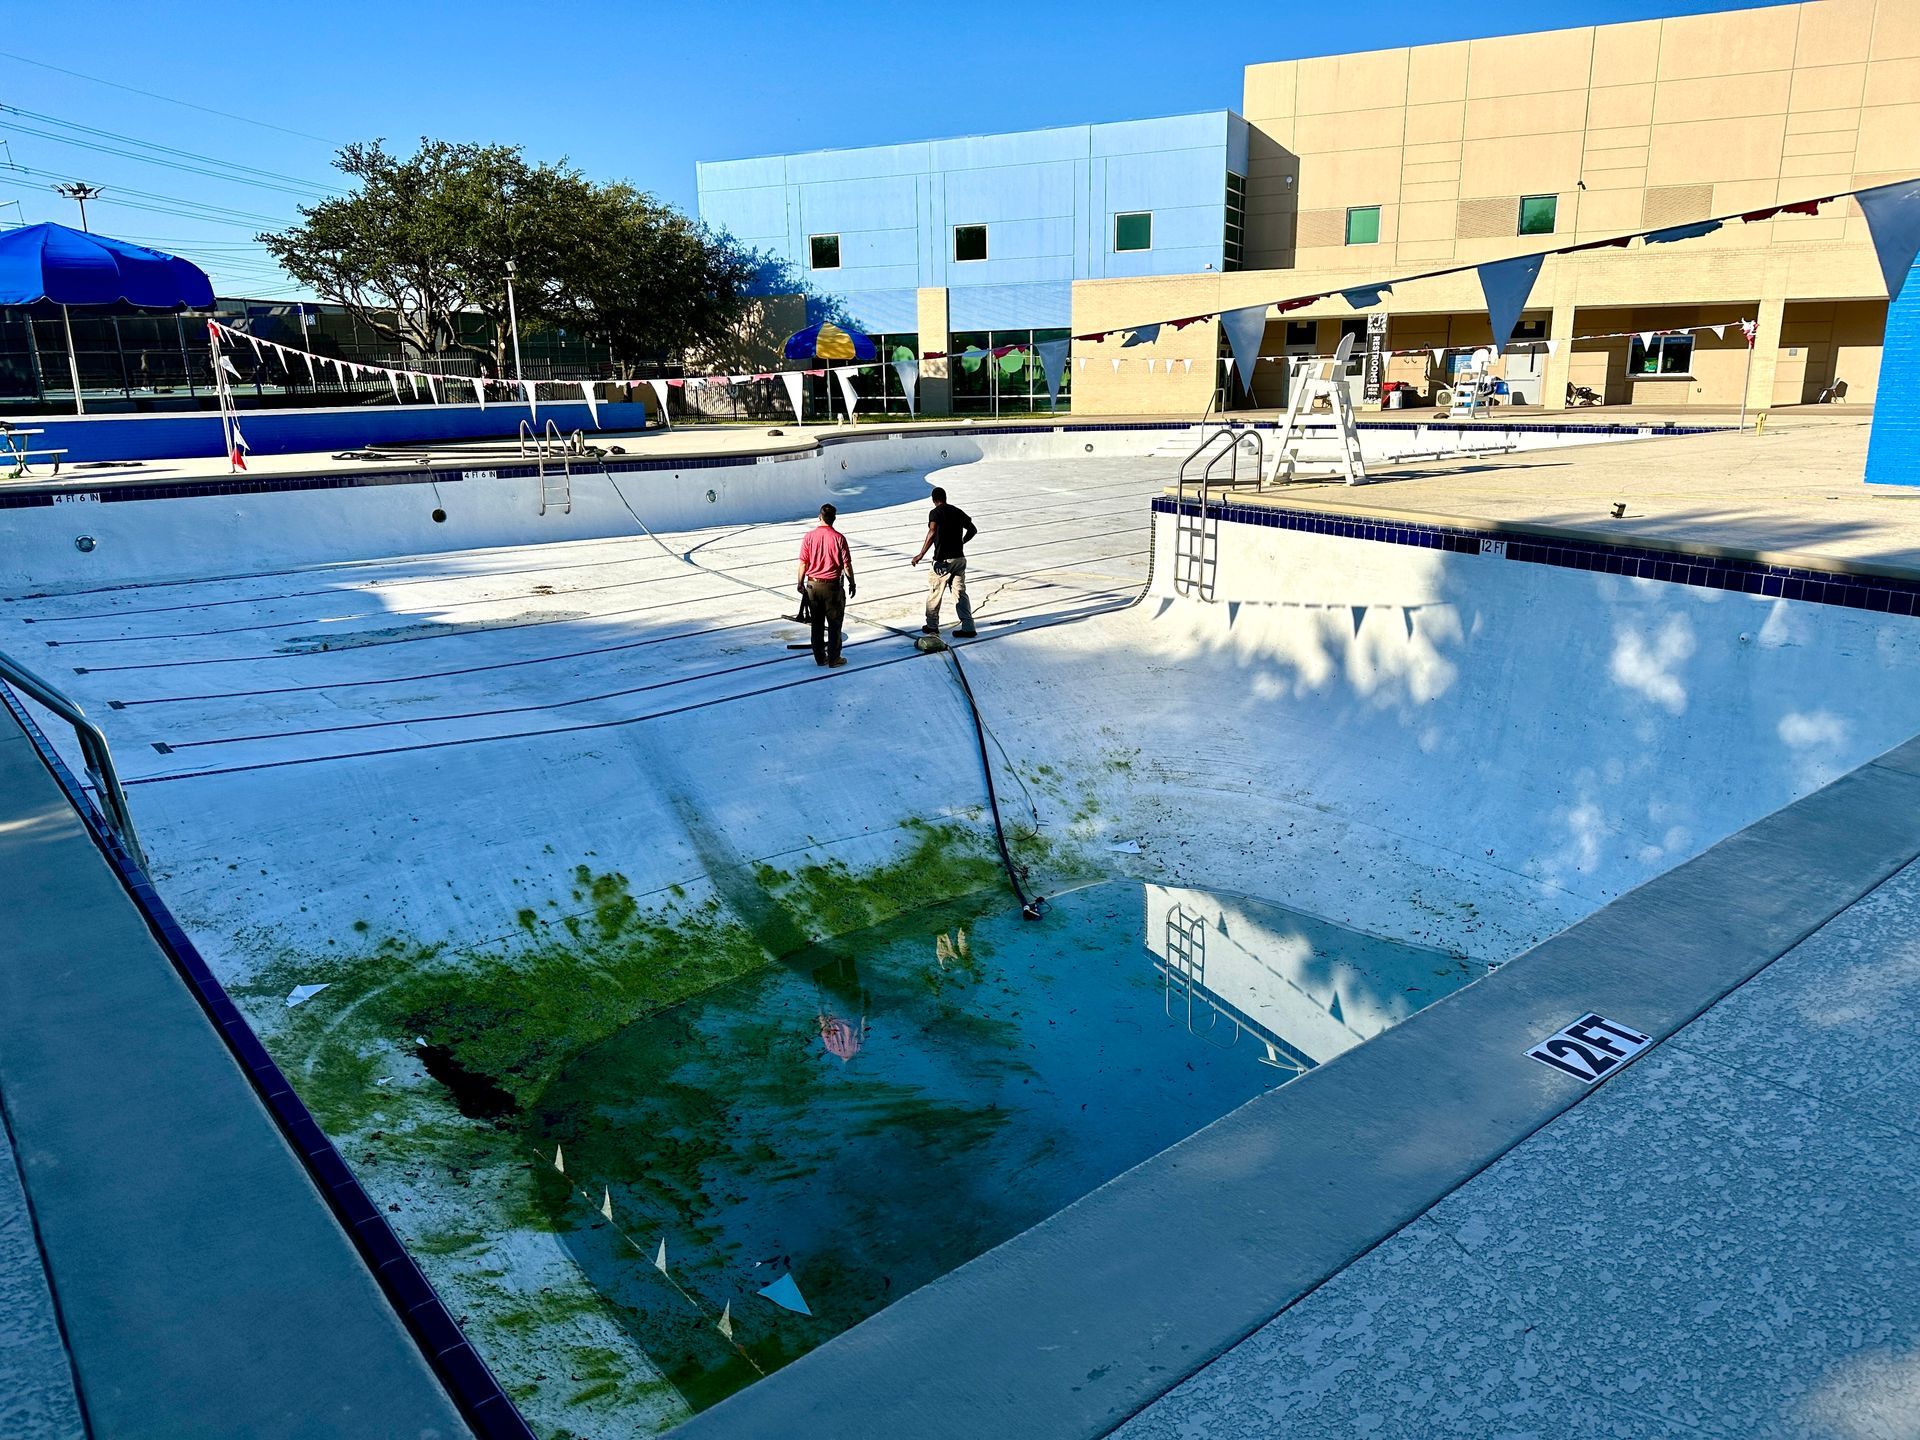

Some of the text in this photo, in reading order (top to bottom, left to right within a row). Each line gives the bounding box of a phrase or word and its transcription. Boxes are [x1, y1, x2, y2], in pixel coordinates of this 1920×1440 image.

[1370, 335, 1381, 384] RESTROOMS
[56, 493, 99, 503] 4 FT 6 IN
[1481, 540, 1505, 554] 12 FT
